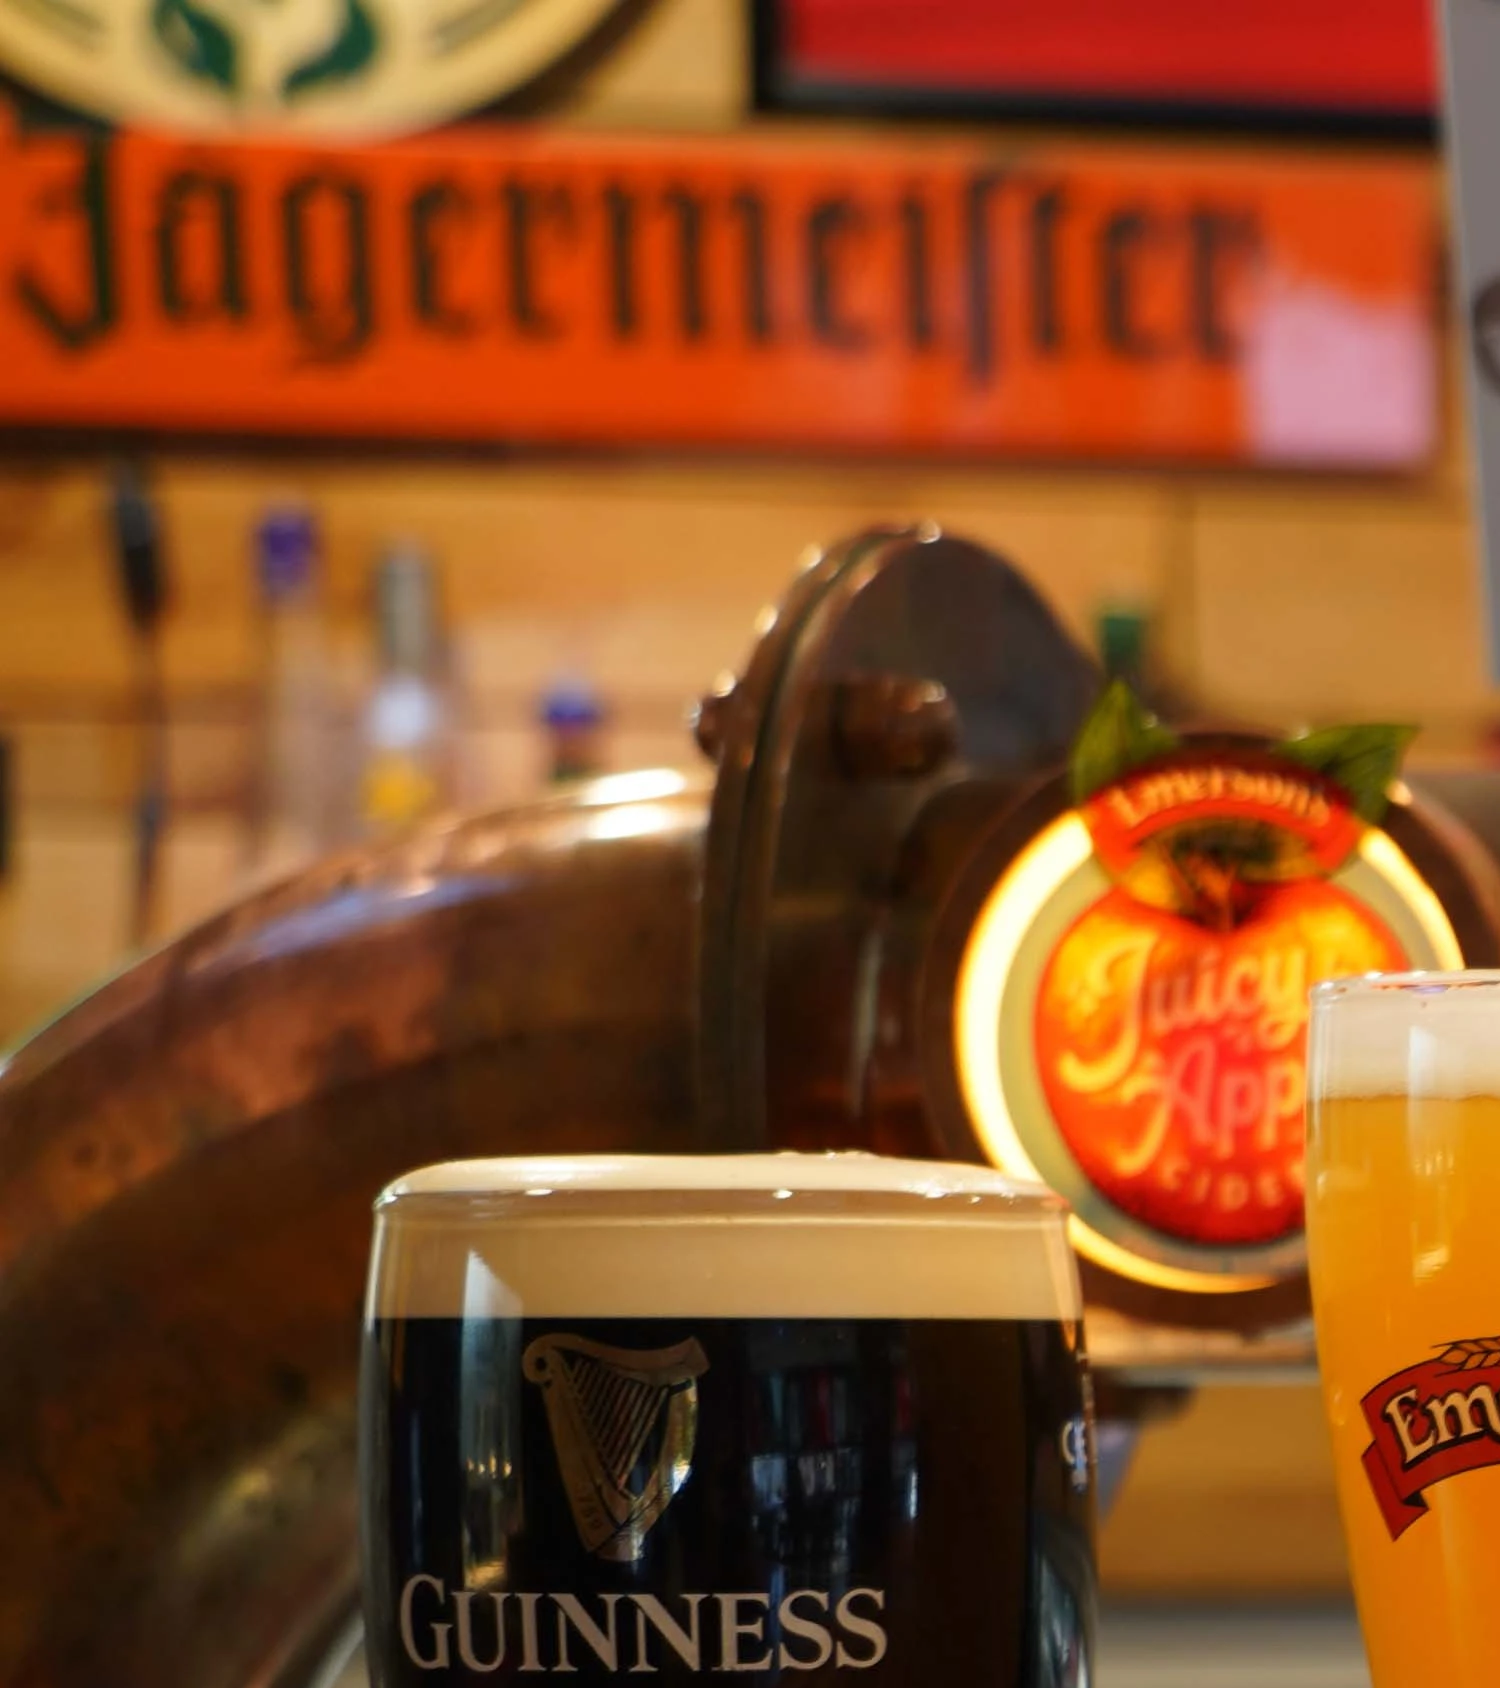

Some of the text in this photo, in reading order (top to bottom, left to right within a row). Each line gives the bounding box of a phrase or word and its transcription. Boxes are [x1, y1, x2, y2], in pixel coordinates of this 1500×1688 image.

[1058, 930, 1310, 1092] Juicy
[1112, 1038, 1308, 1177] App
[403, 1572, 890, 1673] GUINNESS
